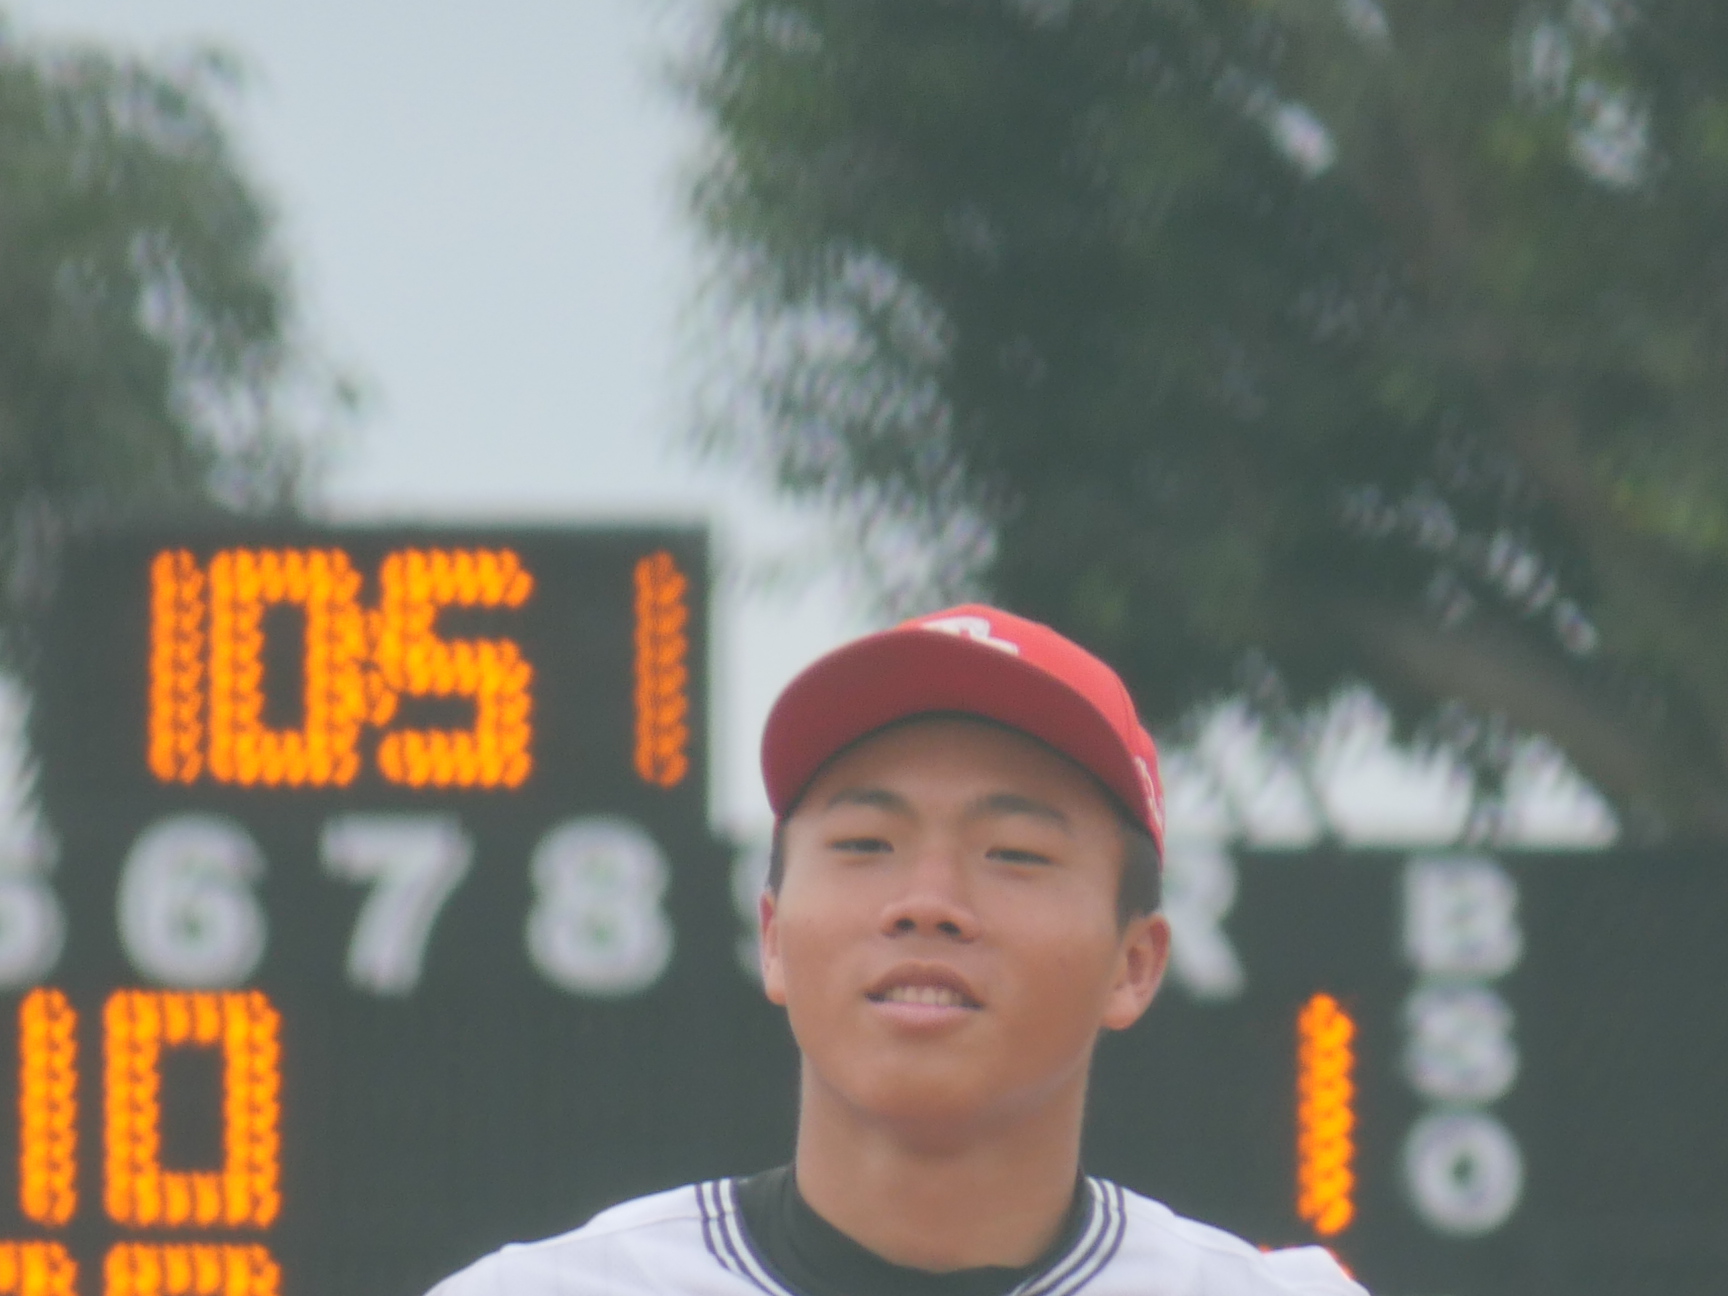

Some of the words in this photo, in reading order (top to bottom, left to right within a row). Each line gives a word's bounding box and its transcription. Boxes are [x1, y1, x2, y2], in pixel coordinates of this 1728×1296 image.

[117, 814, 266, 991] 6
[320, 814, 472, 995] 7
[524, 814, 671, 995] 8
